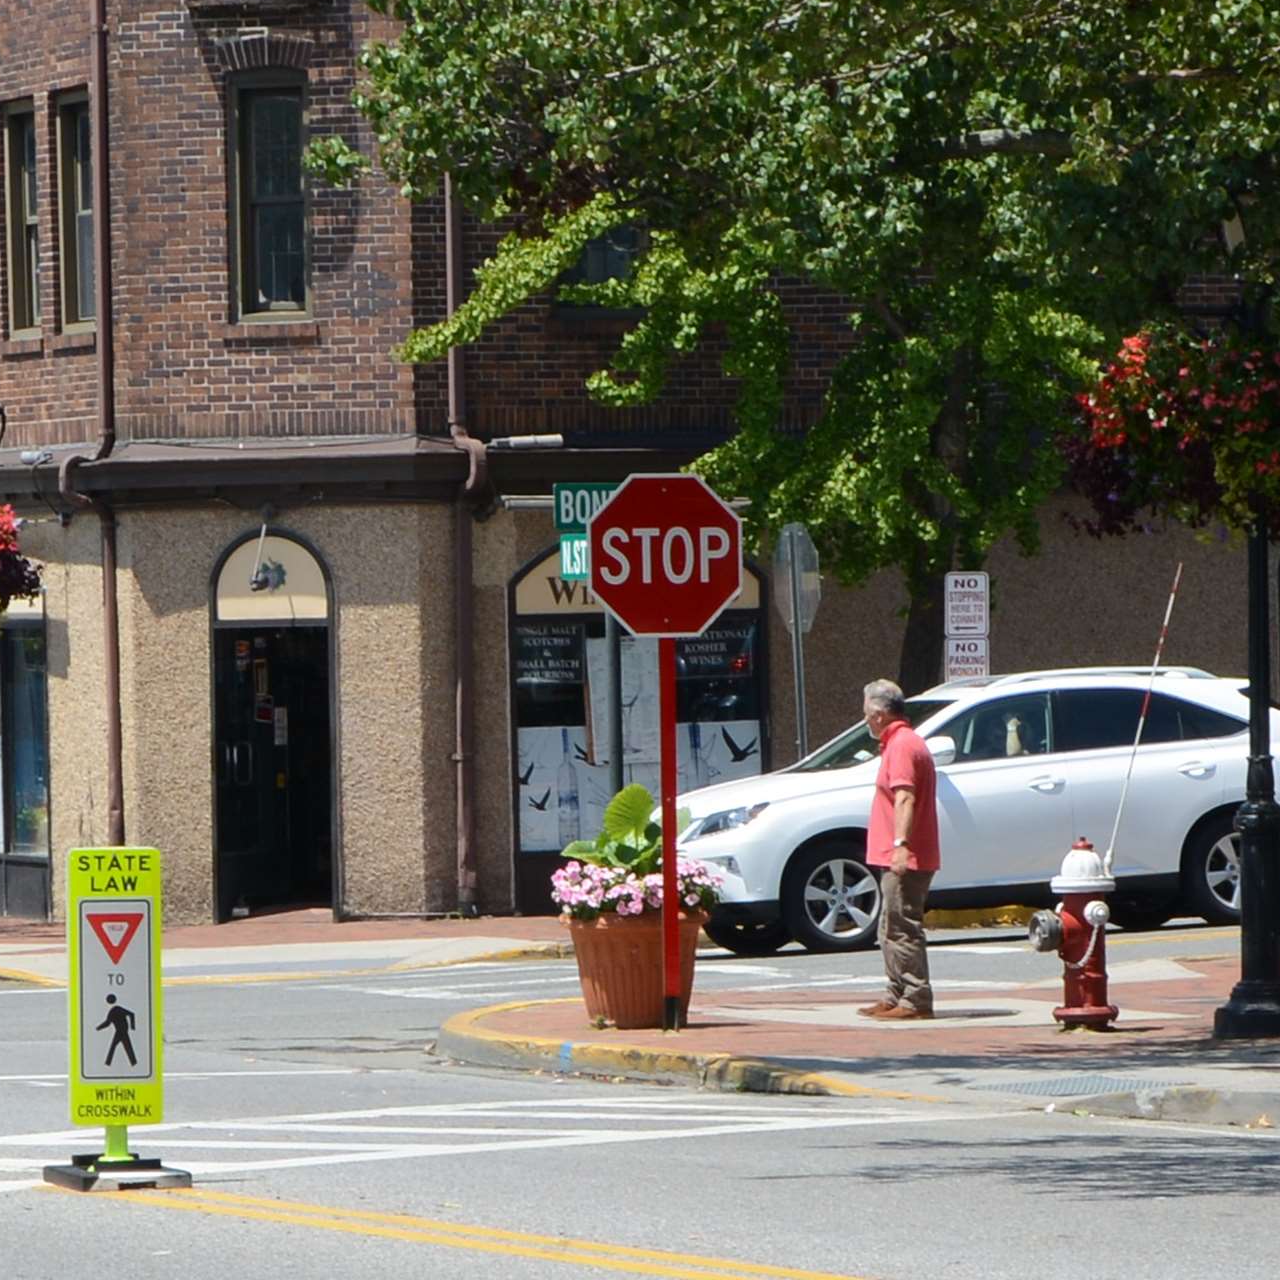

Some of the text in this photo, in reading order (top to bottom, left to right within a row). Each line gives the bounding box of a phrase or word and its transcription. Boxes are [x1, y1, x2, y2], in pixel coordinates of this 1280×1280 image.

[560, 490, 616, 524] BON
[599, 526, 731, 585] STOP
[954, 579, 978, 589] NO
[949, 592, 985, 602] STOPPING
[951, 604, 984, 613] HERE TO
[950, 614, 984, 624] CORNER
[684, 642, 728, 653] KOSHER
[955, 642, 978, 652] NO
[689, 655, 723, 665] WINES
[949, 655, 985, 665] PARKING
[950, 666, 984, 676] MONDAY
[78, 855, 151, 871] STATE
[91, 876, 138, 892] LAW
[107, 973, 125, 986] TO
[95, 1087, 136, 1101] WITHIN
[77, 1104, 153, 1118] CROSSWALK
